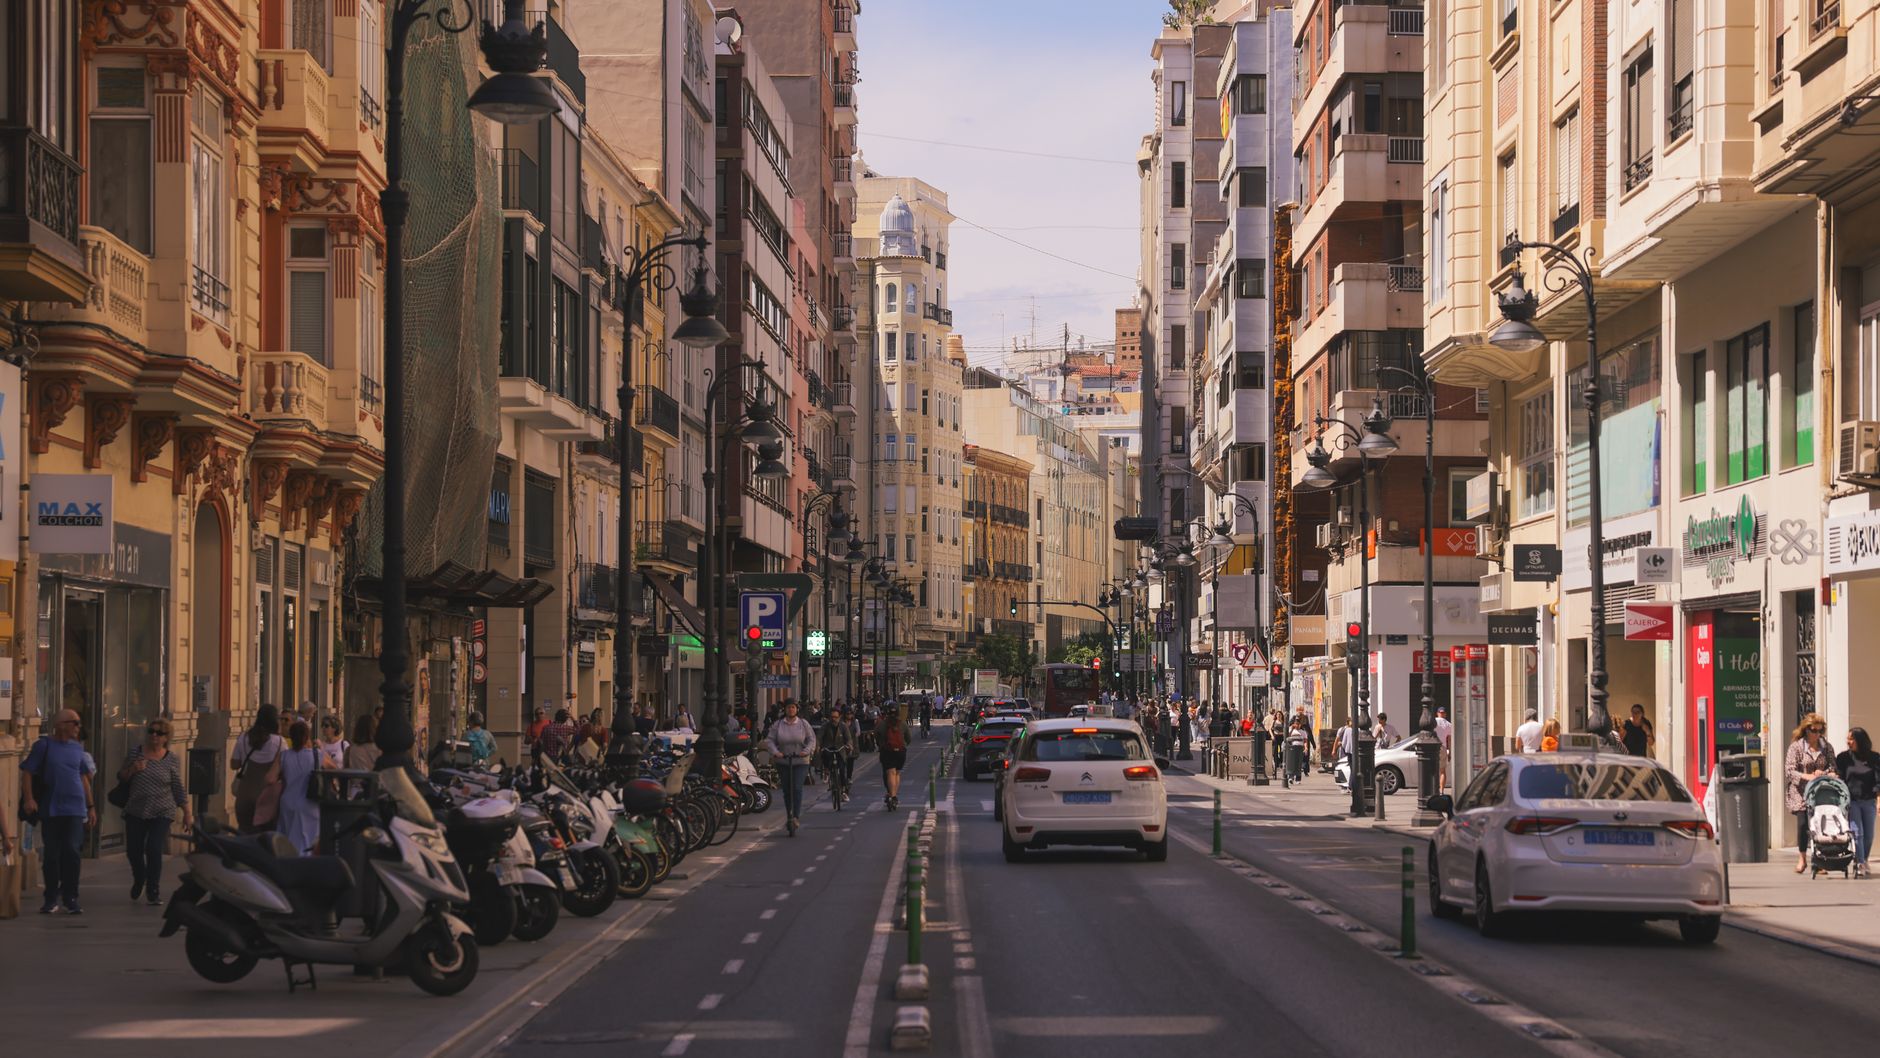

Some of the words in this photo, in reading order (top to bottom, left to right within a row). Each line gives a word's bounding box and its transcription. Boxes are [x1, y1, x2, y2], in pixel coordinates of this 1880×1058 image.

[38, 502, 103, 516] MAX
[1687, 507, 1730, 549] Carrefour
[749, 597, 777, 626] P
[1492, 626, 1534, 634] DECIMAS
[1627, 618, 1658, 627] CAJERO
[1730, 652, 1760, 671] Hol
